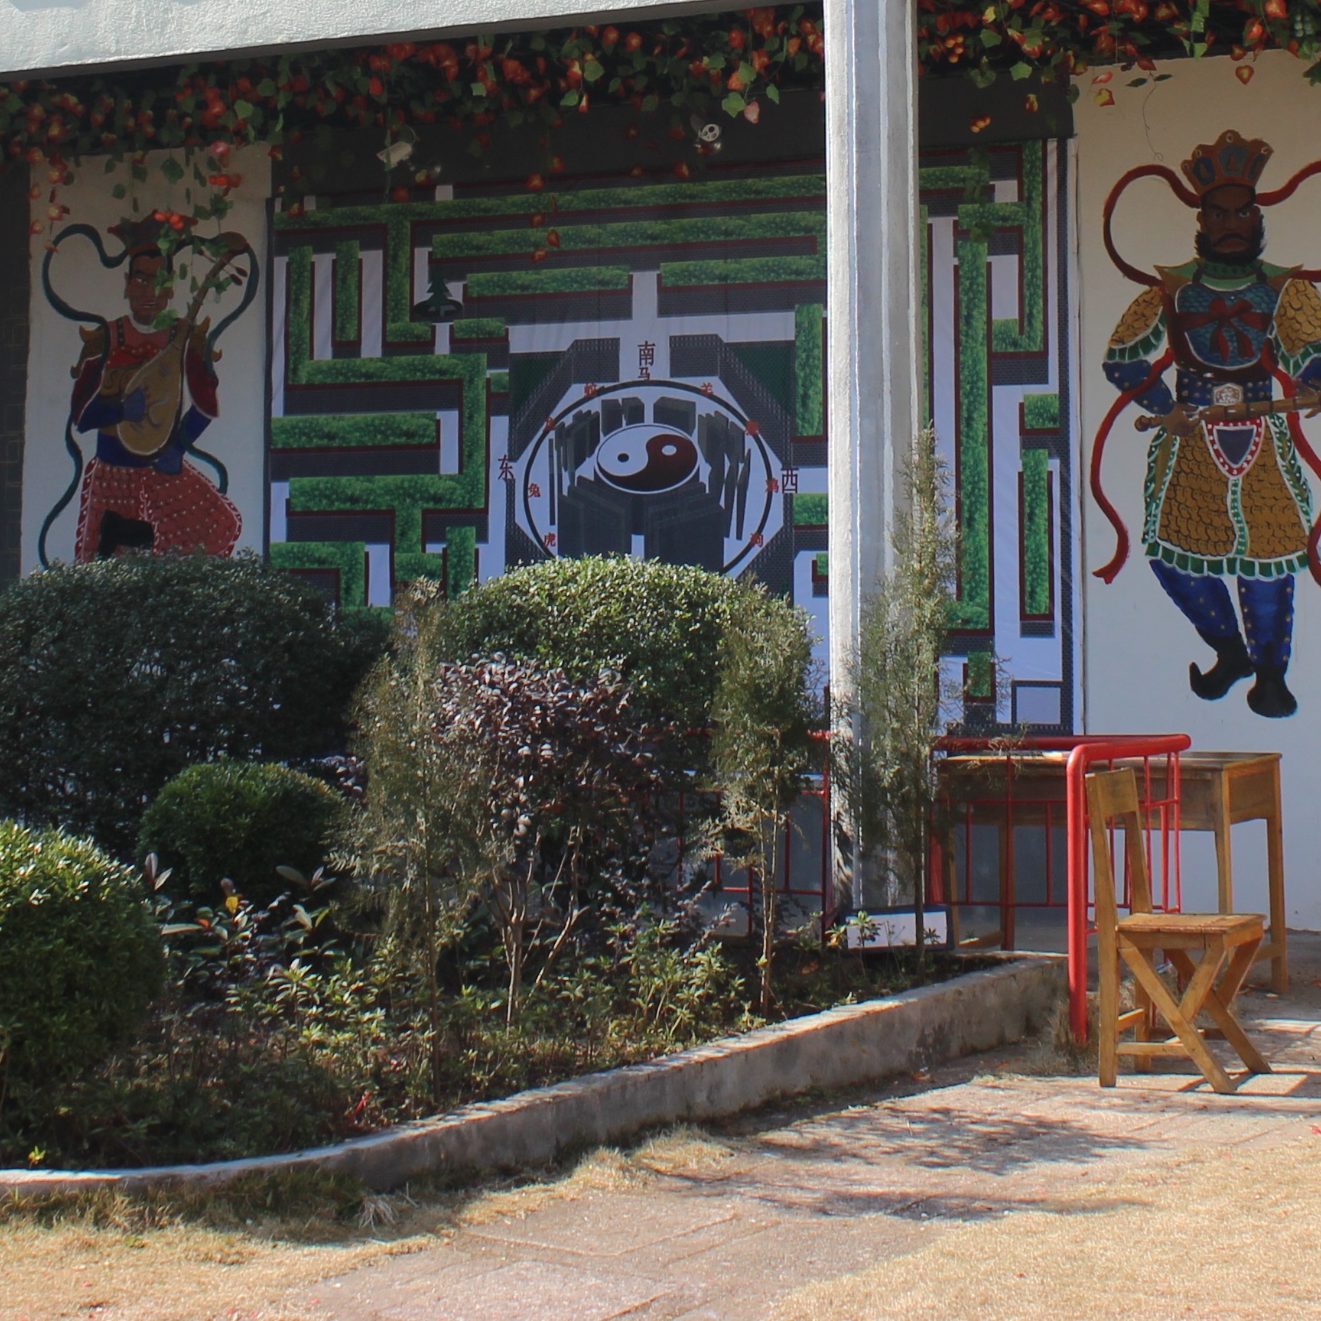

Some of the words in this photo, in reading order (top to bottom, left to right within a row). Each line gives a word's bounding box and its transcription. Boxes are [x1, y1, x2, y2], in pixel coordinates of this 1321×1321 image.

[638, 340, 656, 366] 南
[638, 367, 651, 381] 马
[498, 454, 514, 480] 东
[528, 482, 541, 498] 兔
[781, 467, 799, 494] 西
[543, 532, 556, 548] 虎
